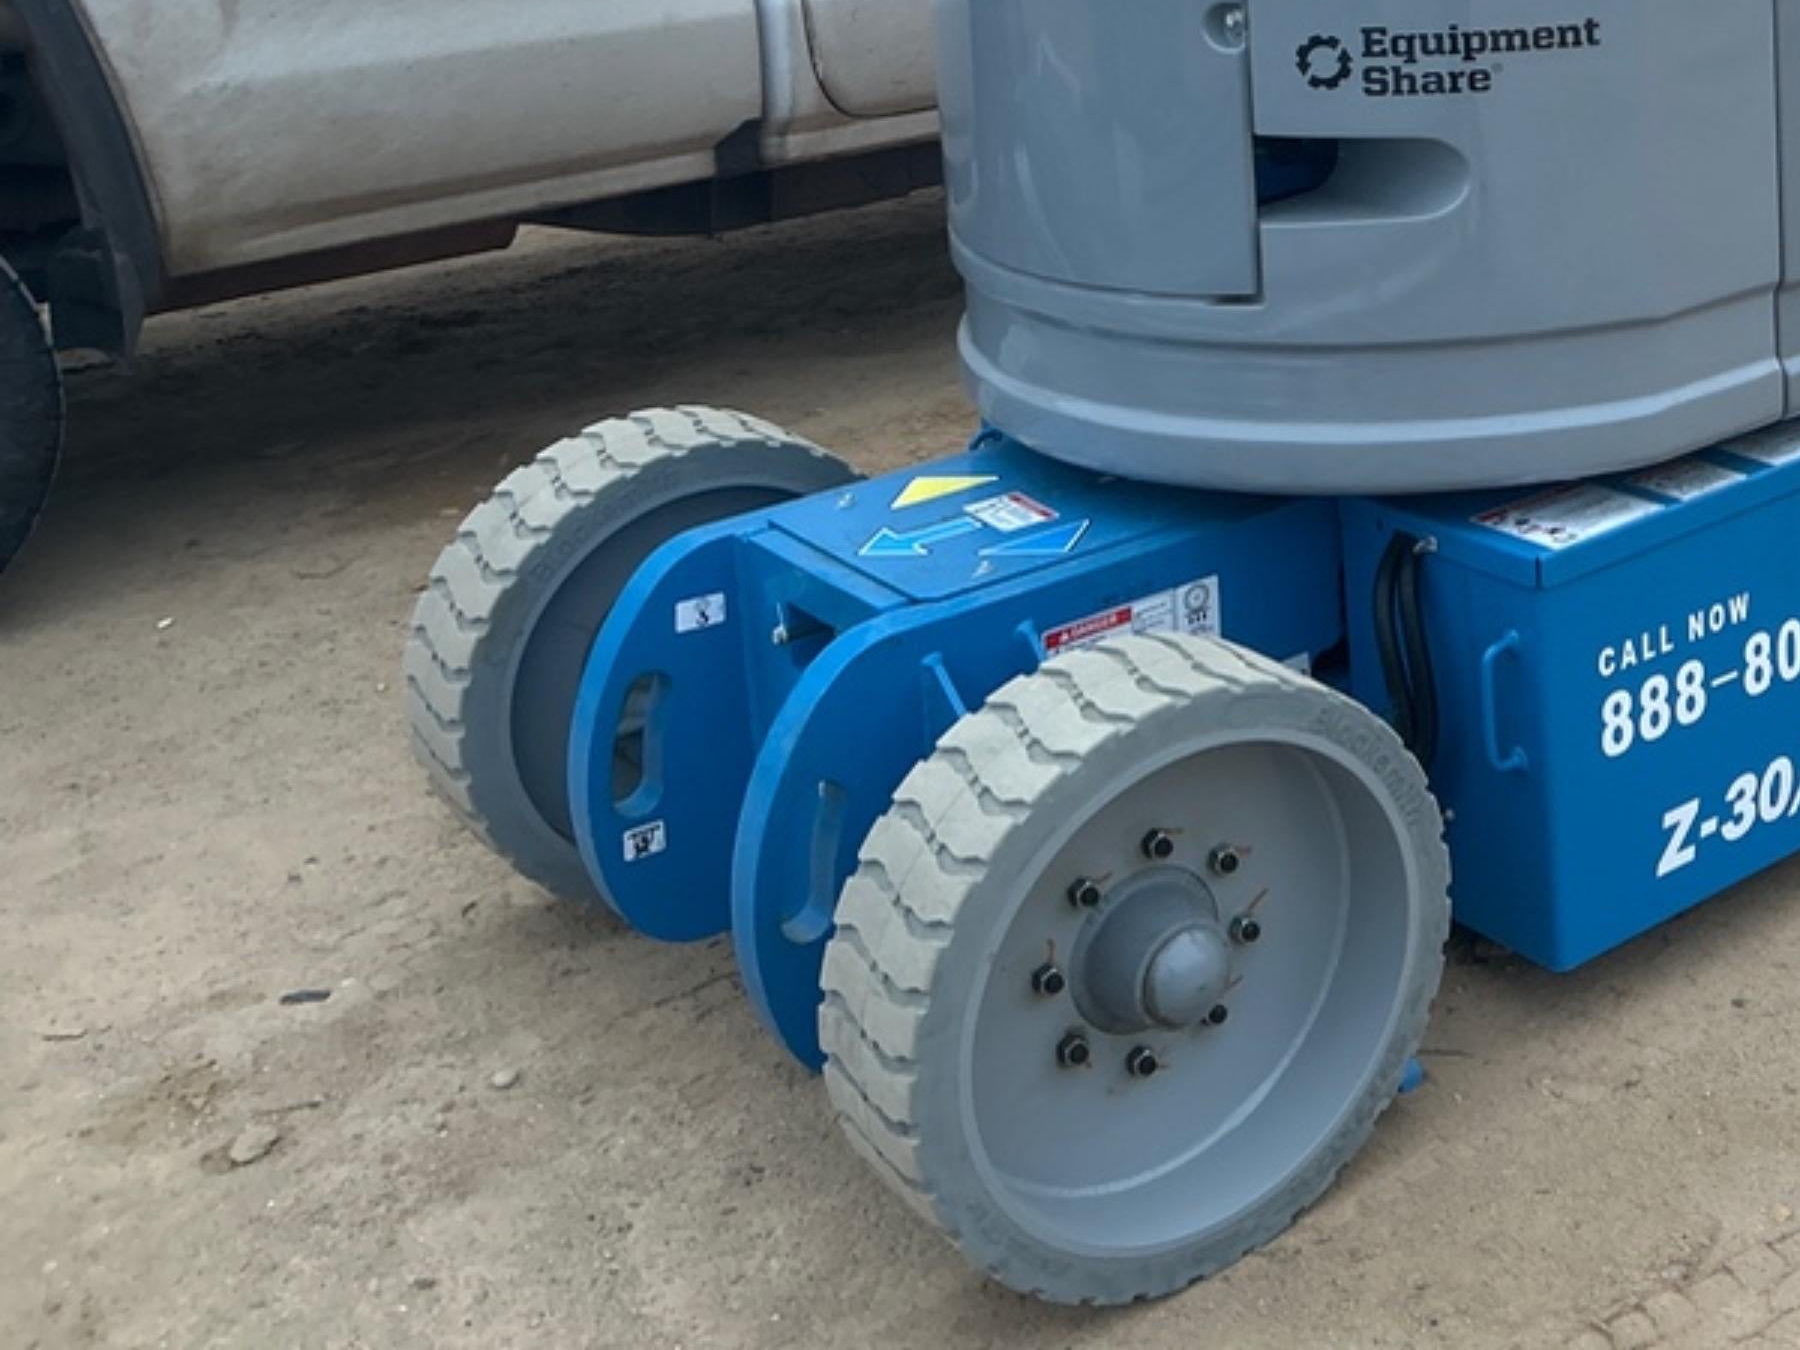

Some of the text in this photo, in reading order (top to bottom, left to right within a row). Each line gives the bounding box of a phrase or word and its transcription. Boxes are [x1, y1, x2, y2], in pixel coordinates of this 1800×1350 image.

[1360, 17, 1601, 64] Equipment
[1361, 65, 1493, 97] Share
[1598, 591, 1751, 677] CALL NOW
